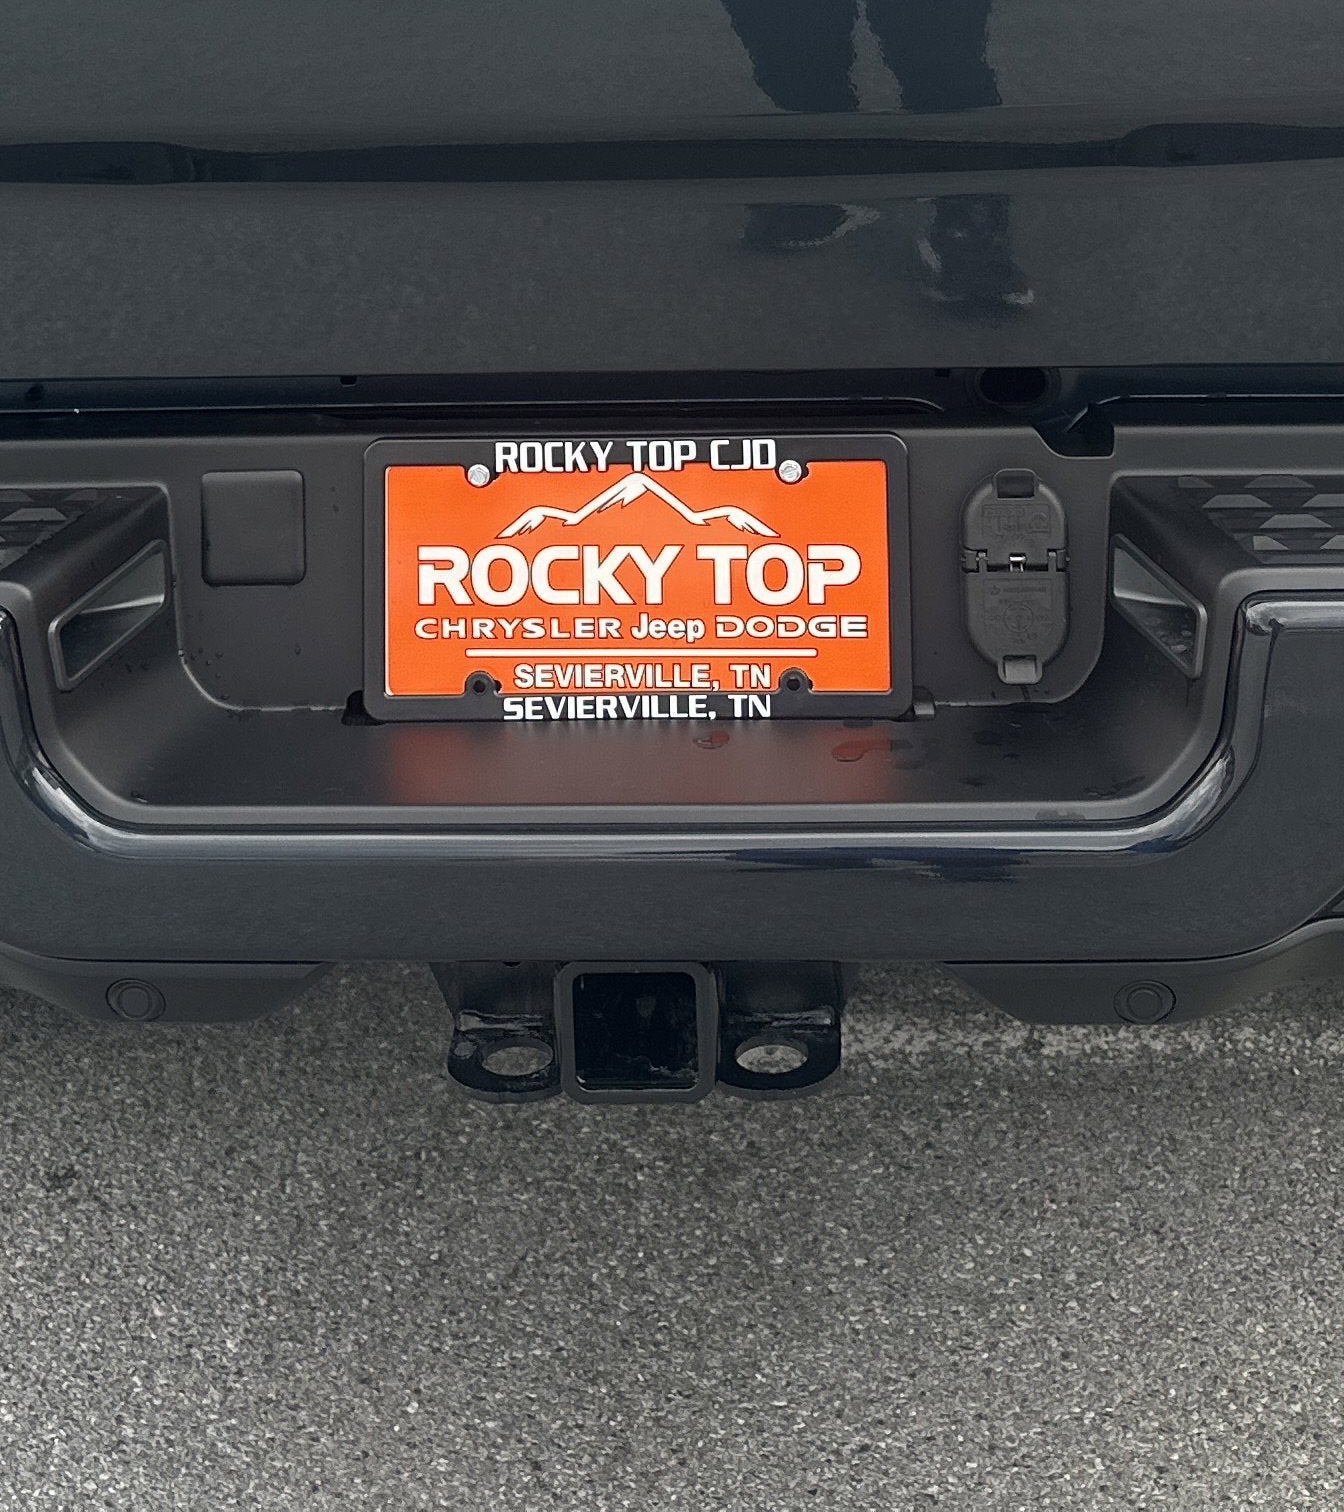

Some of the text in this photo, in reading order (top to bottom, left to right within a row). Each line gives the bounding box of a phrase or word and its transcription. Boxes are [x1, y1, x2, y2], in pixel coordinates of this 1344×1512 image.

[494, 438, 777, 473] ROCKY TOP CJD
[417, 543, 863, 606] ROCKY TOP
[414, 613, 869, 644] CHRYSLER Jeep DODGE
[513, 663, 772, 692] SEVIERVILLE, TN
[502, 694, 772, 721] SEVIERVILLE, TN
